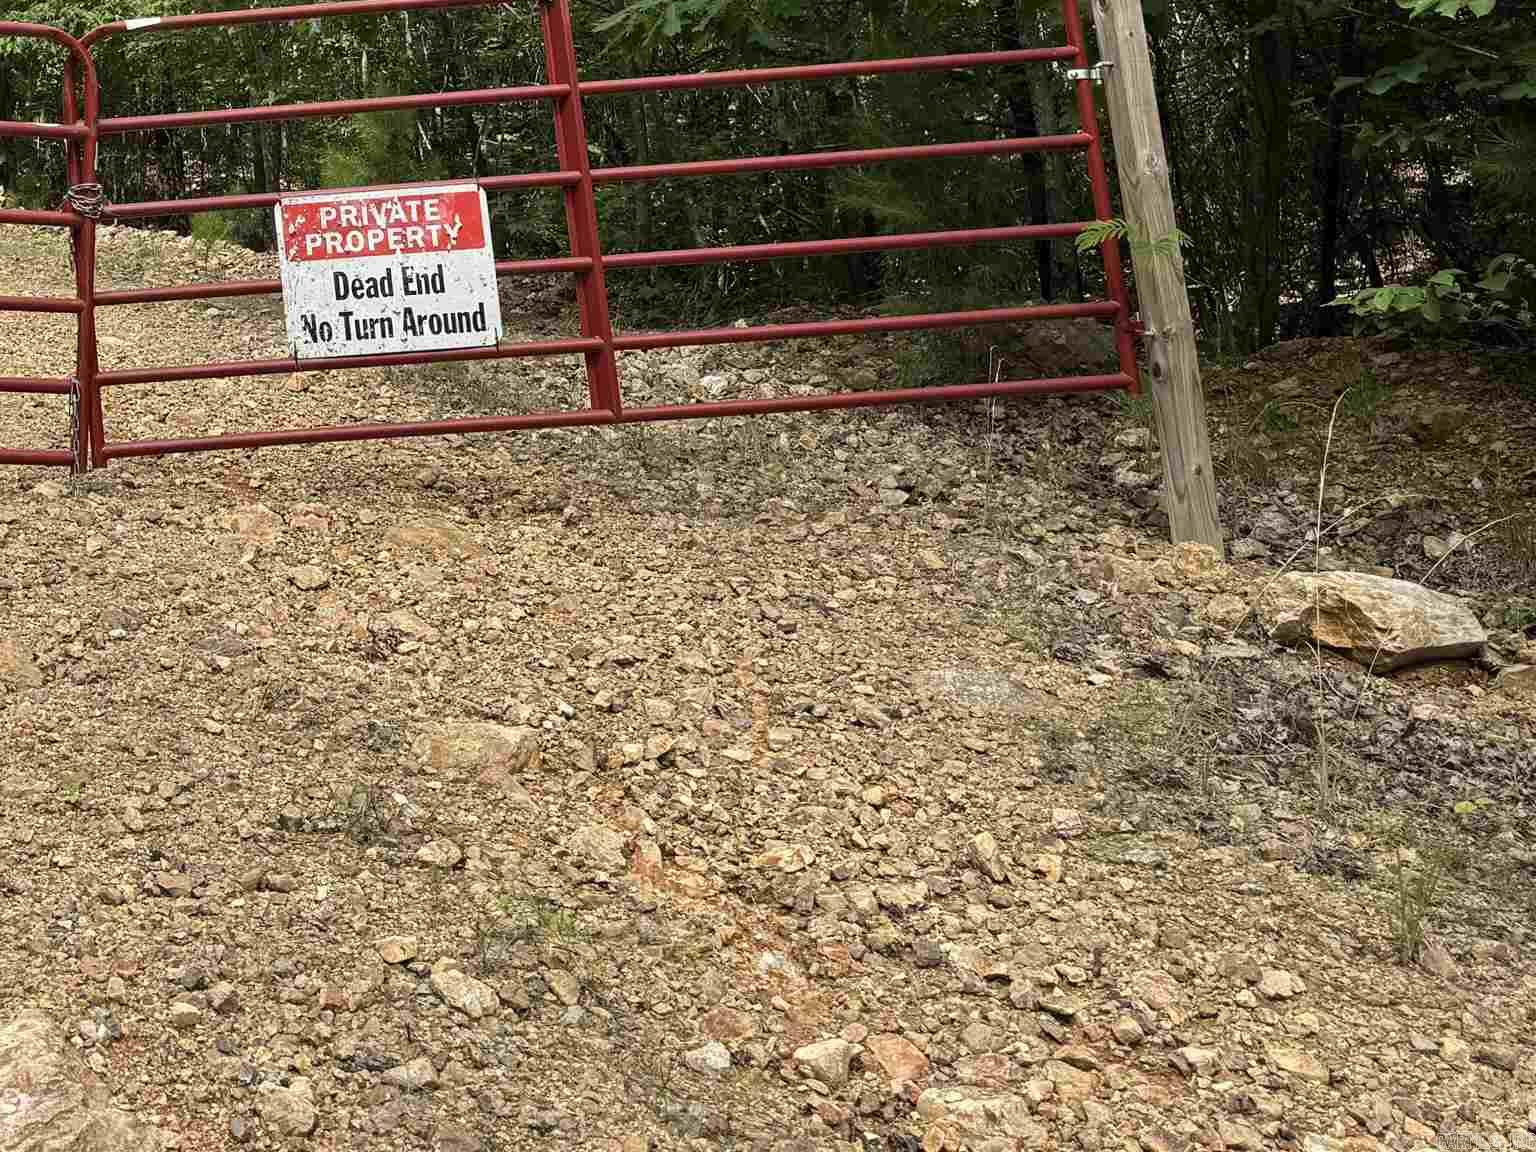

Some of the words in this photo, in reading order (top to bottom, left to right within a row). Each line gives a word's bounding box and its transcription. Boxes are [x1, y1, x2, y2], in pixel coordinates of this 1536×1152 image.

[320, 198, 440, 229] PRIVATE
[304, 218, 462, 255] PROPERTY
[333, 268, 394, 301] Dead
[401, 263, 445, 296] End
[302, 314, 333, 344] No
[339, 310, 394, 341] Turn
[402, 302, 487, 338] Around
